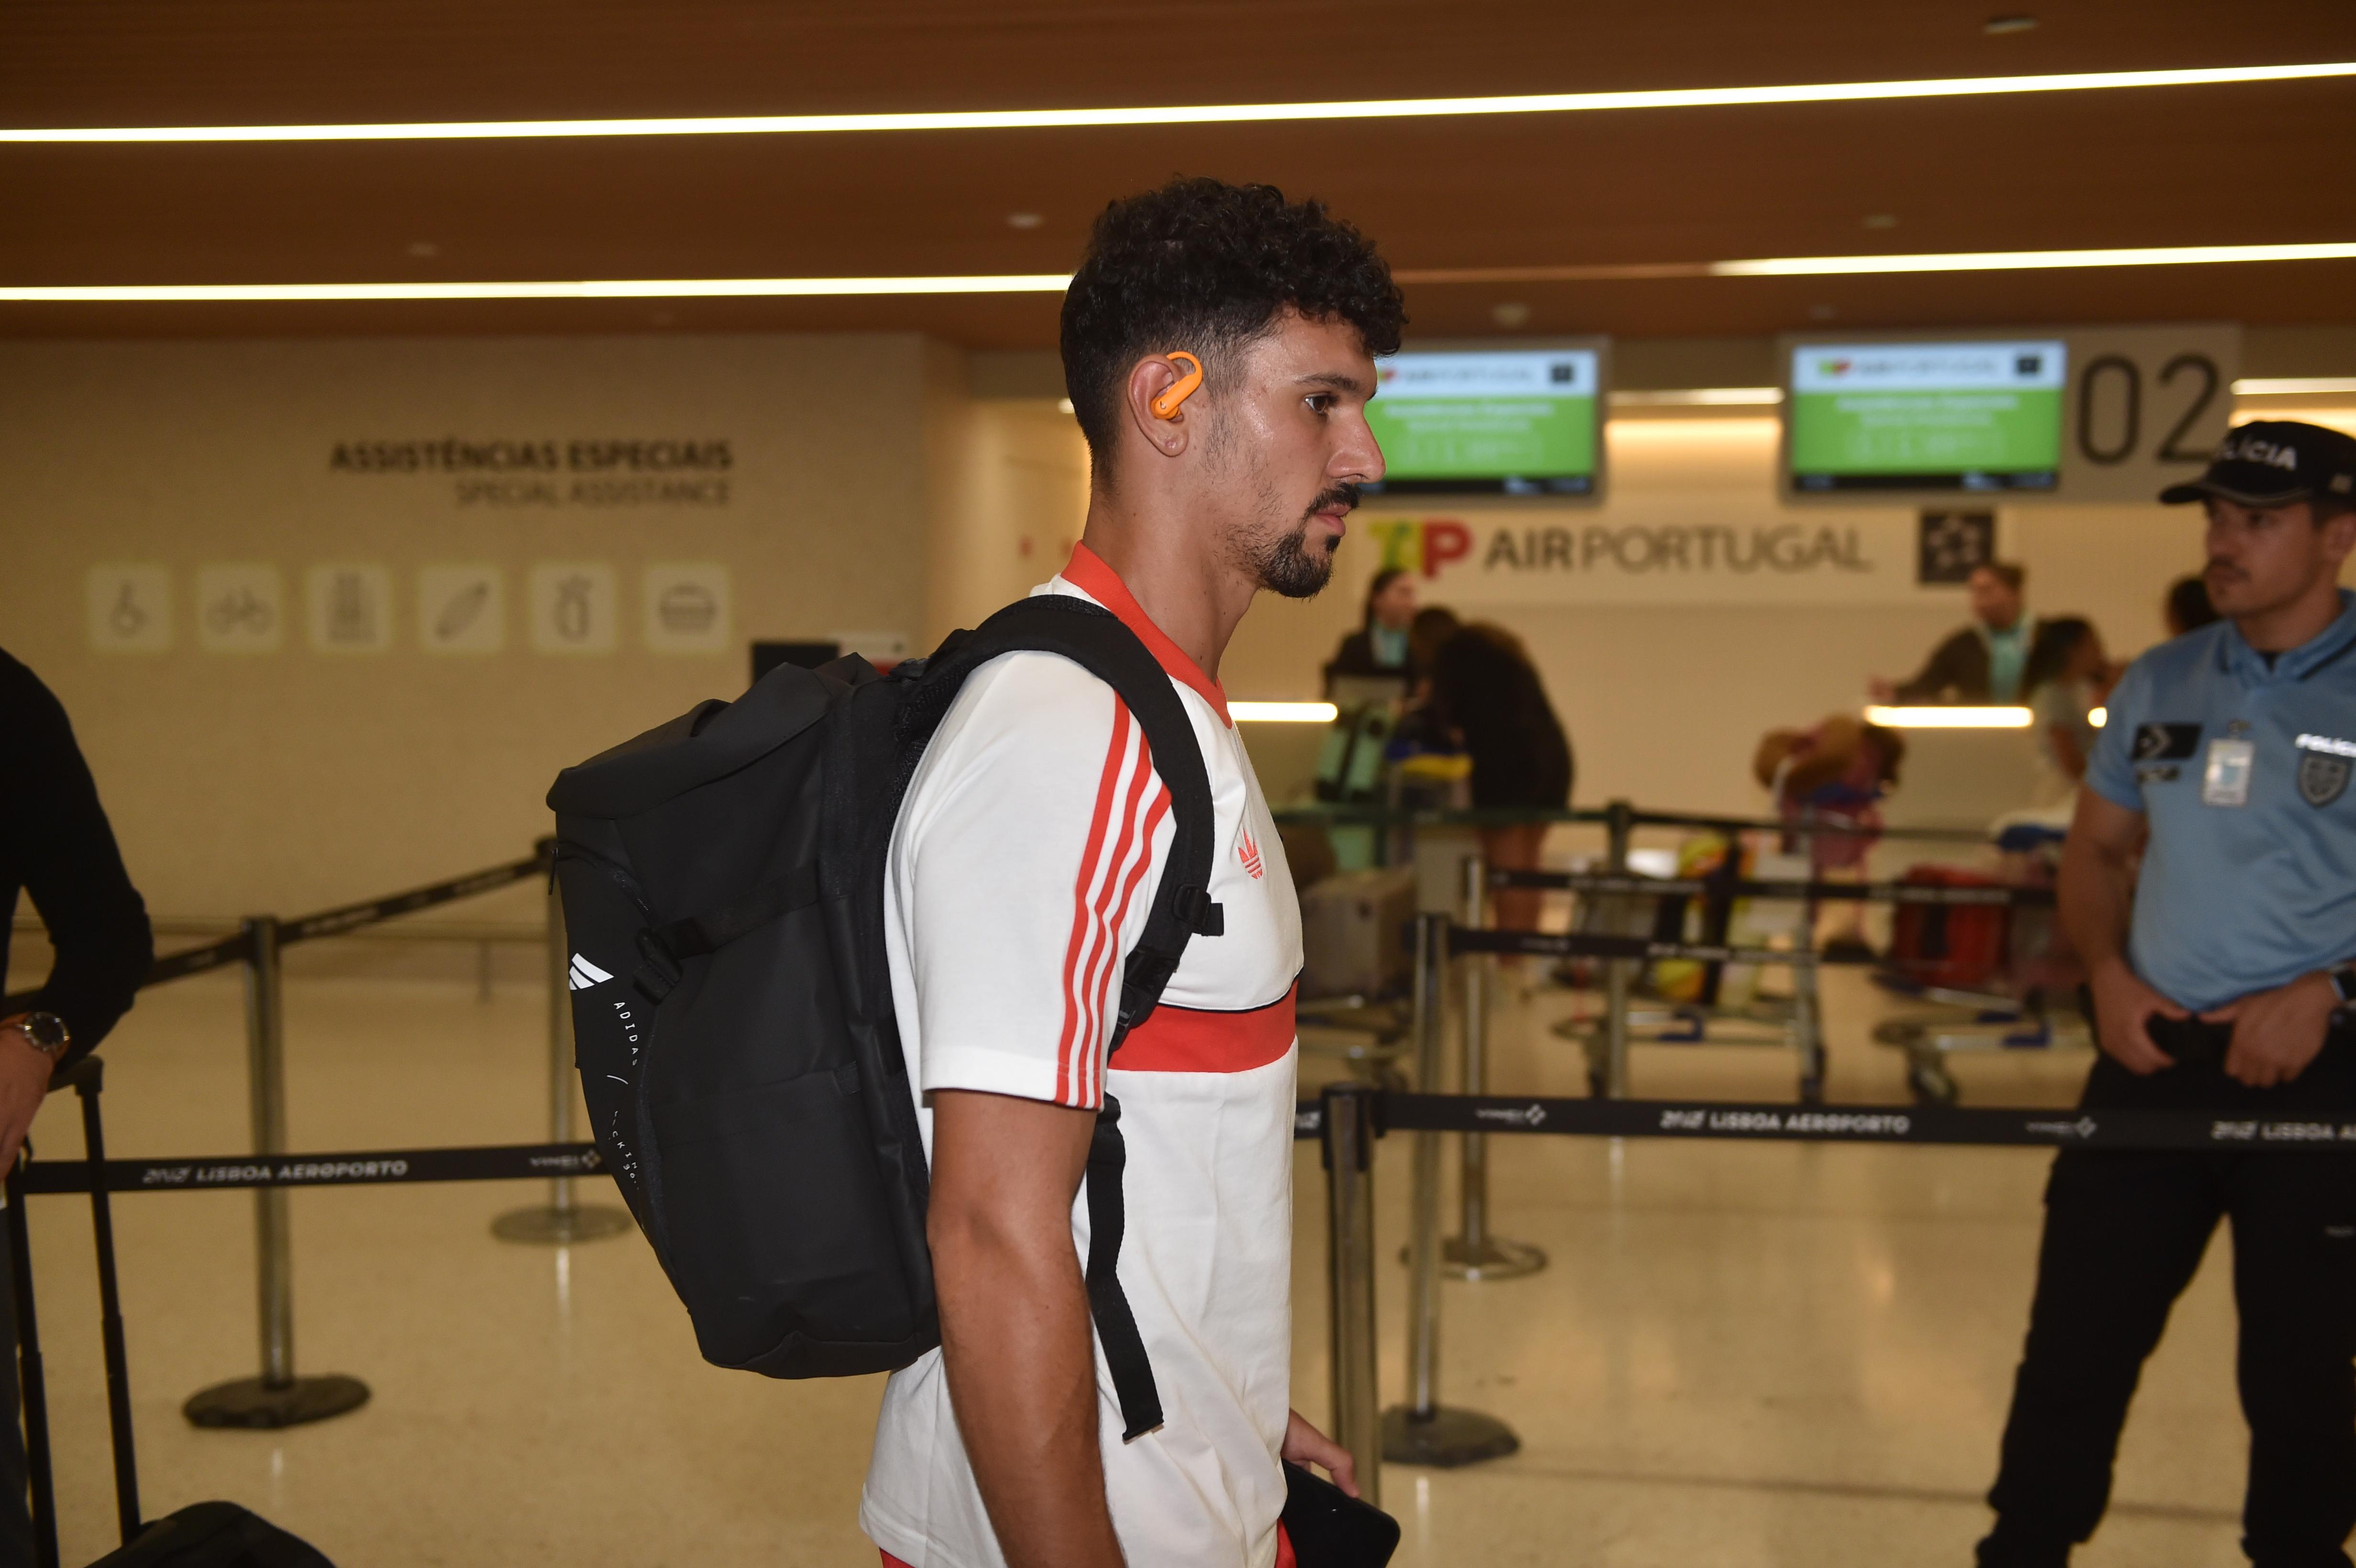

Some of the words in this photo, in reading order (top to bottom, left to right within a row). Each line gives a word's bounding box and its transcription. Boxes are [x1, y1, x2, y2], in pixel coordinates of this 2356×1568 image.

[2078, 353, 2219, 466] 02
[330, 436, 559, 471] ASSISTÊNCIAS
[568, 439, 733, 471] ESPECIAIS
[613, 1002, 639, 1066] ADIDAS
[1710, 1111, 1781, 1131] LISBOA
[1785, 1113, 1910, 1134] AEROPORTO
[196, 1165, 272, 1183] LISBOA
[277, 1159, 409, 1180] AEROPORTO
